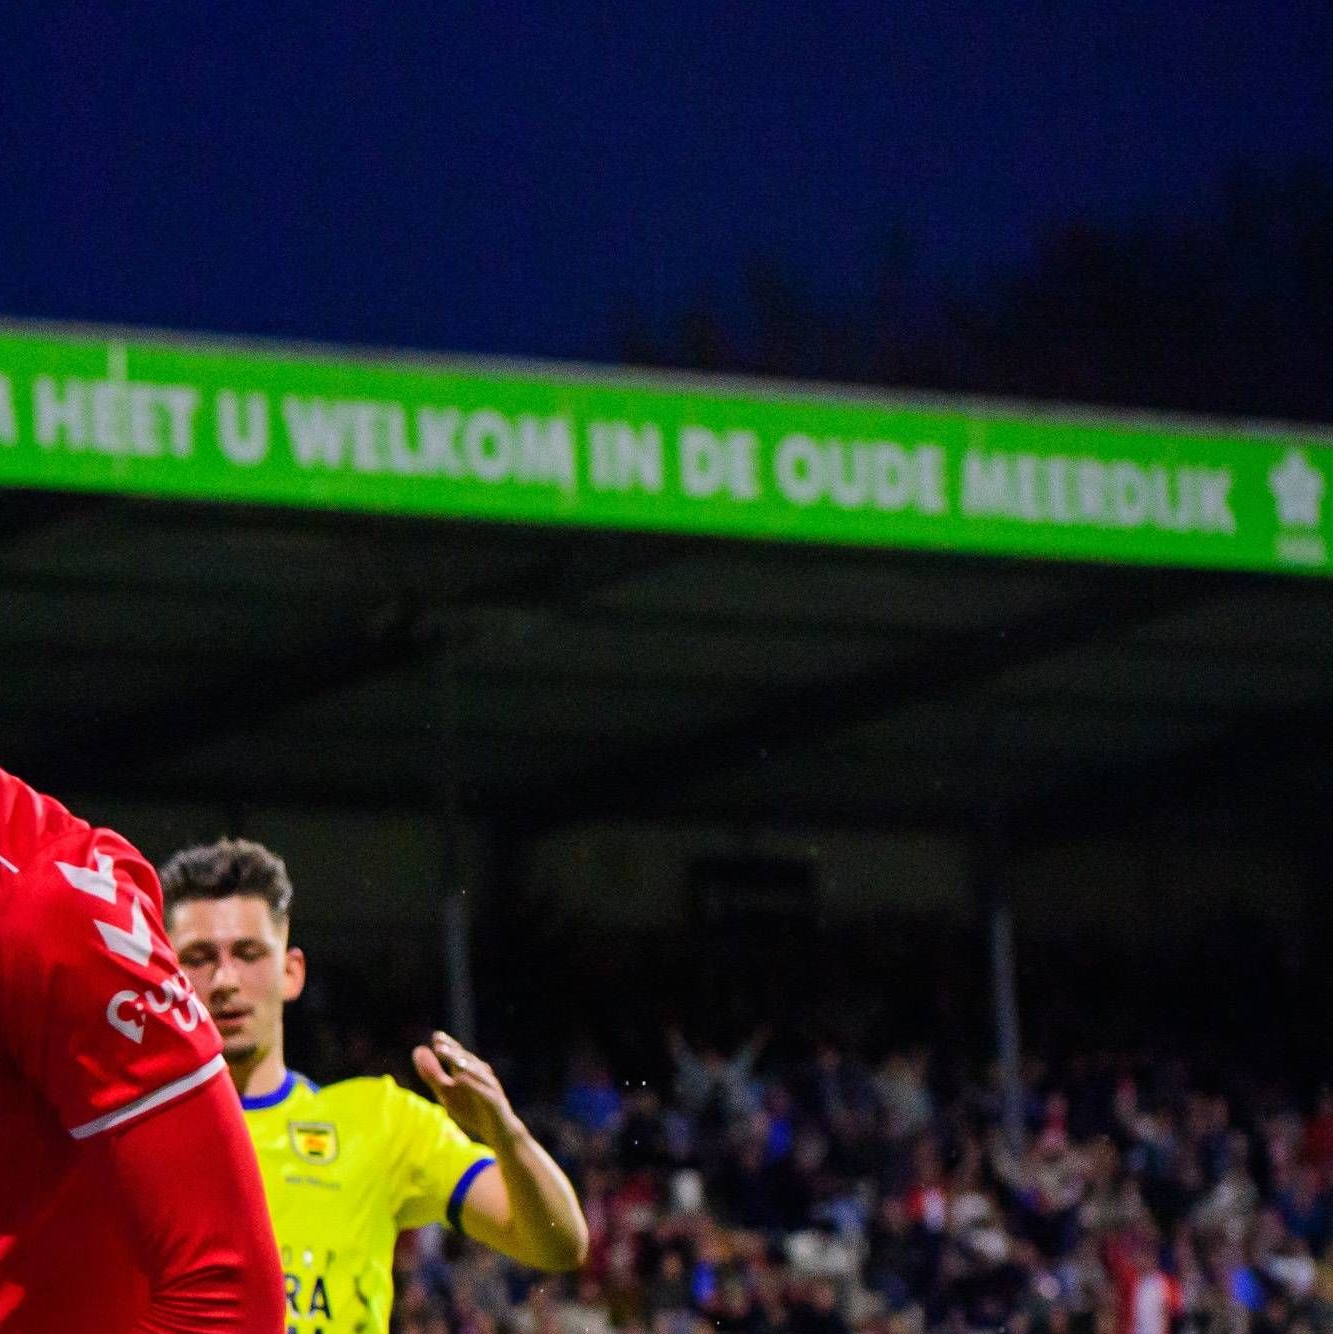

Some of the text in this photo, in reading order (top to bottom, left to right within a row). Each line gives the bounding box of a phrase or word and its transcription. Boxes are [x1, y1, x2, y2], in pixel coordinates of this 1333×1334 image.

[32, 376, 198, 458] HEET
[216, 388, 271, 468] U
[282, 395, 577, 490] WELKOM
[587, 420, 663, 494] IN
[678, 424, 761, 502] DE
[773, 432, 948, 516] OUDE
